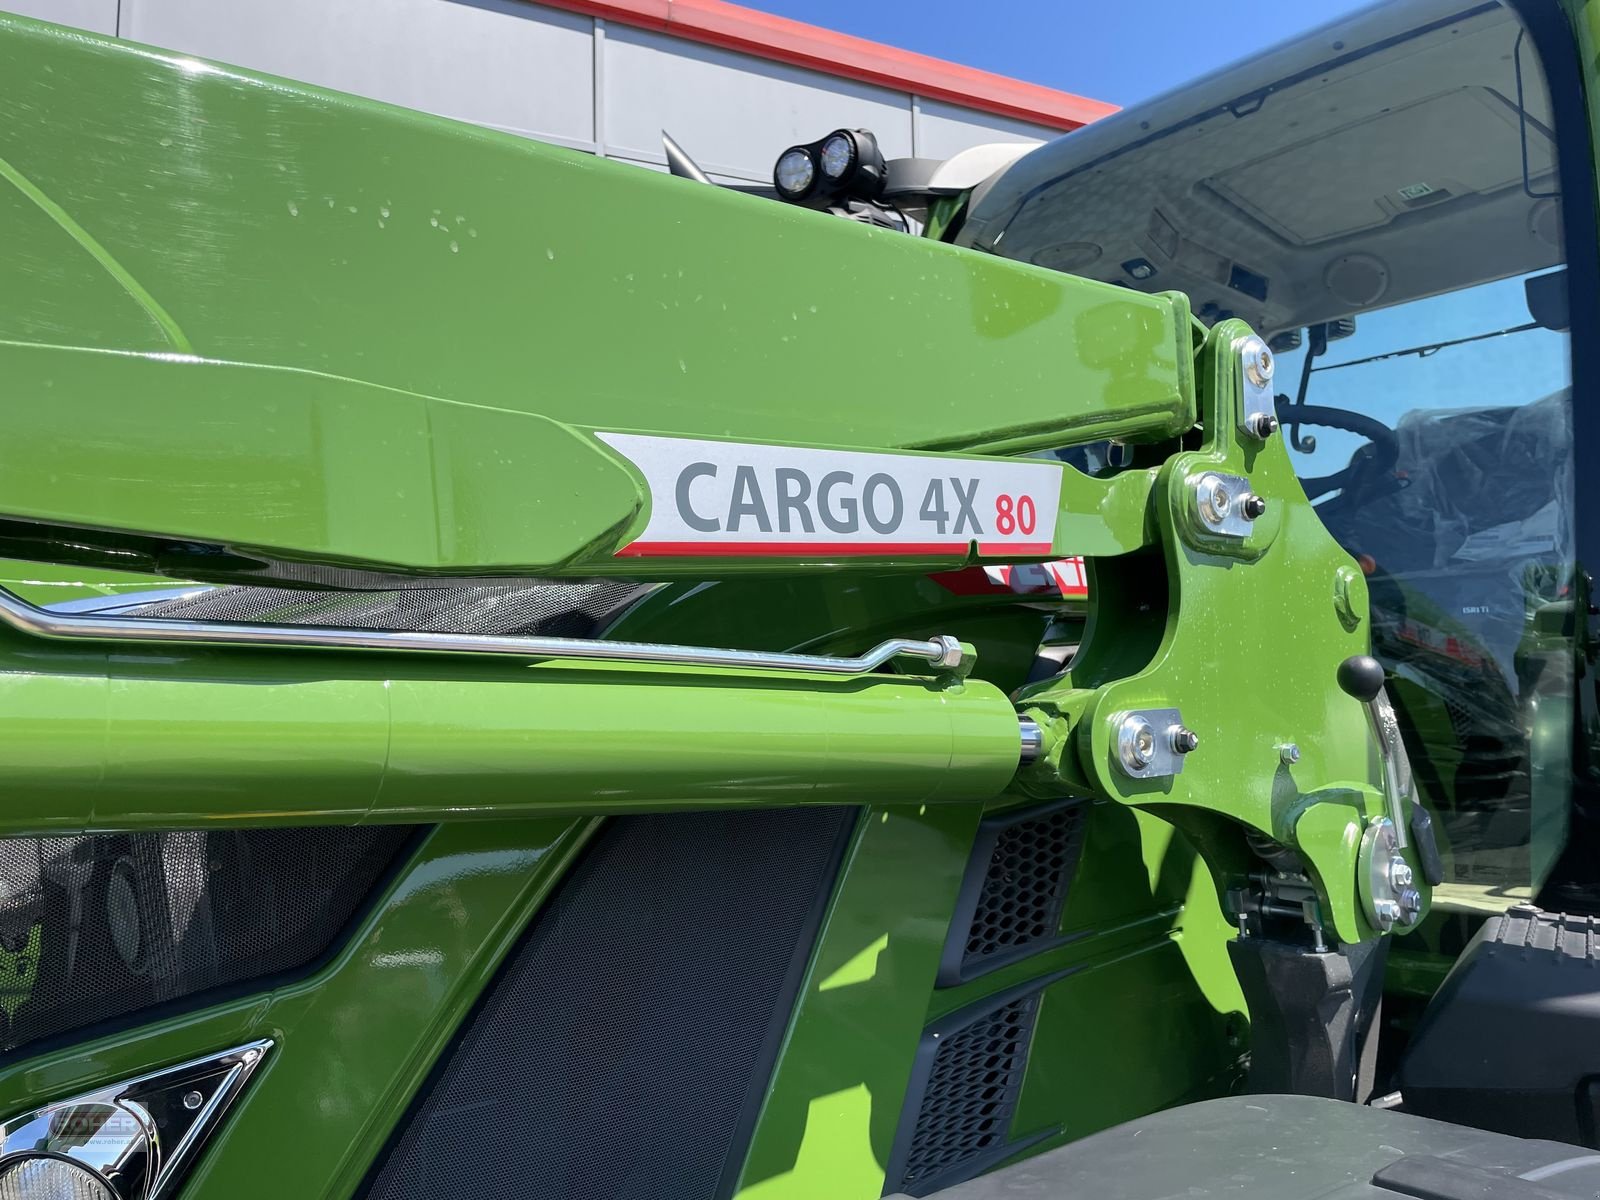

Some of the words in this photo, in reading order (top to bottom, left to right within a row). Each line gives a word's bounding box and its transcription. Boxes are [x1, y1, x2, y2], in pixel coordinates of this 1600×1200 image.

[674, 461, 904, 535] CARGO
[918, 477, 984, 535] 4X
[995, 494, 1037, 536] 80
